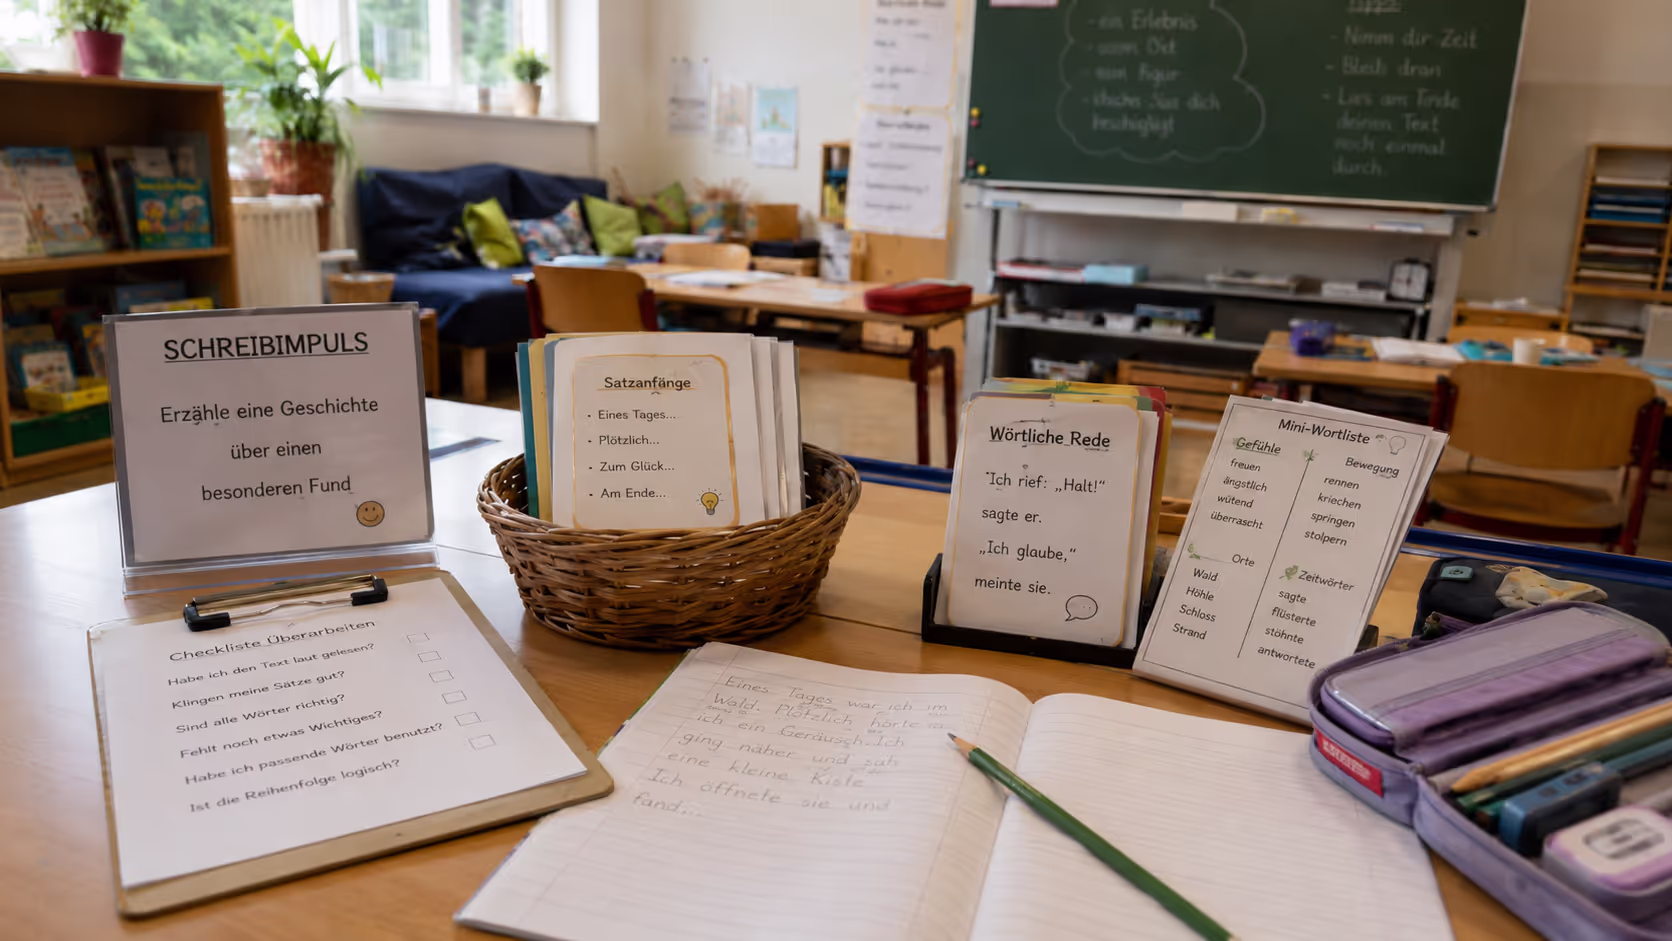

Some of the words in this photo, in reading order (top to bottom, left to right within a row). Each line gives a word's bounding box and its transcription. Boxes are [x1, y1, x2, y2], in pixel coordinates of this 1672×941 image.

[1131, 9, 1198, 31] Erlebnis
[1344, 26, 1394, 46] Nimm
[1402, 27, 1429, 46] dir
[1440, 29, 1477, 49] Zeit
[1397, 58, 1442, 77] dran
[1403, 113, 1440, 133] Text
[164, 332, 369, 361] SCHREIBIMPULS
[604, 376, 691, 391] Satzanfänge
[160, 404, 230, 423] Erzähle
[237, 404, 274, 419] eine
[280, 397, 379, 417] Geschichte
[598, 410, 629, 420] Eines
[632, 409, 676, 422] Tages...
[598, 435, 660, 445] Plötzlich...
[989, 426, 1064, 445] Wörtliche
[1070, 431, 1111, 448] Rede
[1278, 418, 1371, 445] Mini-Wortliste
[230, 443, 270, 460] über
[276, 440, 322, 457] einen
[1236, 437, 1281, 455] Gefühle
[600, 462, 626, 472] Zum
[630, 461, 675, 472] Glück...
[1230, 458, 1261, 472] freuen
[1345, 457, 1400, 479] Bewegung
[201, 482, 303, 501] besonderen
[309, 475, 351, 493] Fund
[1018, 475, 1048, 489] rief:
[1223, 476, 1268, 493] ängstlich
[1323, 477, 1360, 490] rennen
[600, 488, 621, 499] Am
[625, 488, 666, 499] Ende...
[1217, 494, 1254, 509] wütend
[1317, 493, 1362, 510] kriechen
[982, 508, 1019, 524] sagte
[1024, 512, 1042, 523] er.
[1210, 511, 1264, 530] überrascht
[1310, 512, 1355, 529] springen
[1304, 530, 1348, 546] stolpern
[1232, 554, 1255, 568] Orte
[1193, 568, 1219, 582] Wald
[1298, 570, 1355, 592] Zeitwörter
[974, 577, 1022, 592] meinte
[1027, 581, 1051, 595] sie.
[1185, 586, 1215, 601] Höhle
[1278, 590, 1307, 605] sagte
[1179, 604, 1216, 622] Schloss
[1271, 606, 1317, 627] flüsterte
[169, 641, 262, 662] Checkliste
[267, 620, 376, 645] Überarbeiten
[1172, 623, 1207, 640] Strand
[1264, 626, 1304, 645] stöhnte
[168, 675, 204, 686] Habe
[208, 669, 228, 679] ich
[232, 664, 257, 674] den
[260, 658, 290, 669] Text
[293, 654, 318, 664] laut
[322, 643, 375, 660] gelesen?
[1257, 646, 1316, 669] antwortete
[172, 694, 224, 709] Klingen
[229, 686, 270, 698] meine
[273, 677, 312, 691] Sätze
[316, 671, 345, 684] gut?
[725, 675, 769, 694] Eines
[788, 687, 833, 707] Tages
[848, 700, 877, 710] war
[888, 701, 913, 711] ich
[714, 693, 760, 712] Wald.
[176, 721, 208, 733] Sind
[213, 715, 239, 727] alle
[242, 705, 291, 721] Wörter
[295, 694, 346, 711] richtig?
[697, 712, 723, 725] ich
[738, 721, 766, 733] ein
[180, 745, 217, 759] Fehlt
[222, 737, 259, 750] noch
[263, 727, 305, 742] etwas
[308, 711, 382, 732] Wichtiges?
[185, 771, 226, 785] Habe
[230, 764, 254, 776] ich
[258, 748, 327, 771] passende
[330, 737, 380, 753] Wörter
[384, 722, 443, 743] benutzt?
[679, 733, 723, 752] ging
[739, 743, 795, 759] näher
[812, 754, 850, 765] und
[667, 751, 711, 767] eine
[728, 760, 789, 781] kleine
[190, 802, 210, 813] Ist
[216, 795, 240, 808] die
[244, 774, 337, 801] Reihenfolge
[341, 759, 401, 779] logisch?
[650, 768, 683, 787] Ich
[700, 780, 781, 804] öffnete
[801, 797, 831, 809] sie
[849, 799, 891, 811] und
